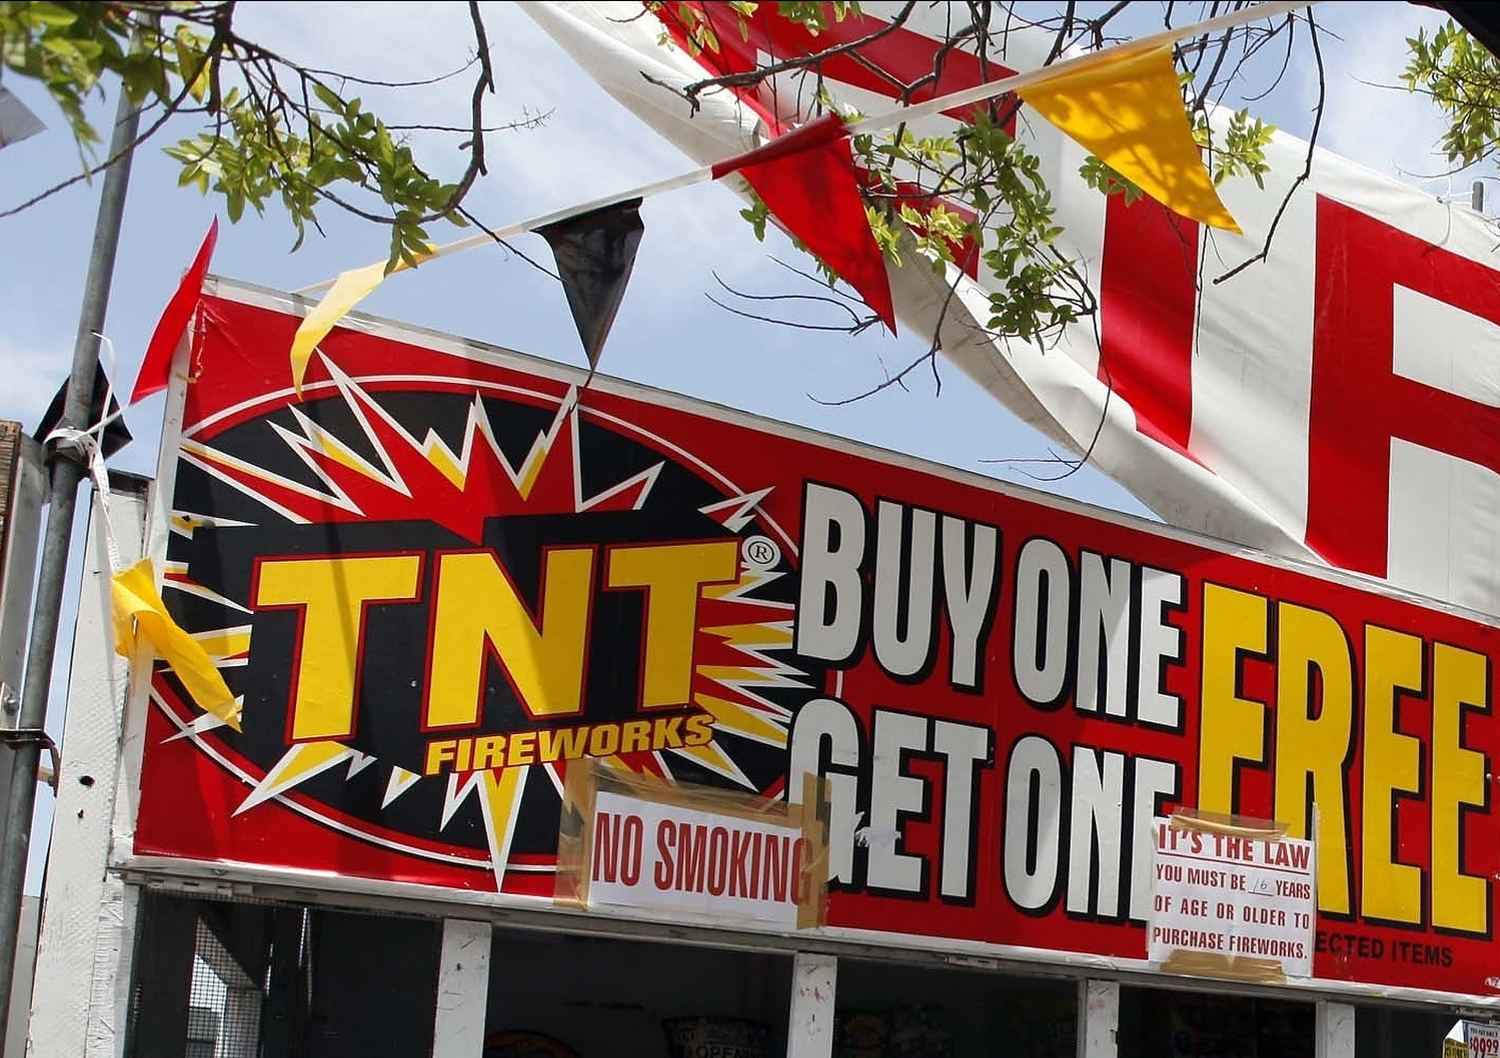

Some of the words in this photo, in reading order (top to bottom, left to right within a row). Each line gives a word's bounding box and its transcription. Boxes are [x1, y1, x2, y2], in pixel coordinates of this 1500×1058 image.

[797, 481, 996, 688] BUY
[1013, 538, 1183, 729] ONE
[253, 538, 744, 747] TNT
[424, 712, 714, 778] FIREWORKS
[1200, 580, 1488, 934] FREE
[789, 698, 989, 898] GET
[1005, 736, 1180, 921] ONE
[592, 811, 644, 887] NO
[653, 818, 815, 907] SMOKING
[1158, 823, 1203, 854] IT'S
[1213, 833, 1254, 862] THE
[1264, 840, 1310, 870] LAW
[1156, 863, 1182, 883] YOU
[1187, 868, 1226, 889] MUST
[1230, 874, 1246, 891] BE
[1275, 879, 1310, 900] YEARS
[1154, 894, 1172, 912] OF
[1180, 898, 1208, 917] AGE
[1216, 902, 1234, 920] OR
[1242, 905, 1286, 926] OLDER
[1293, 911, 1310, 930] TO
[1153, 926, 1224, 950] PURCHASE
[1228, 934, 1308, 960] FIREWORKS.
[1314, 930, 1386, 960] ECTED
[1391, 941, 1454, 968] ITEMS
